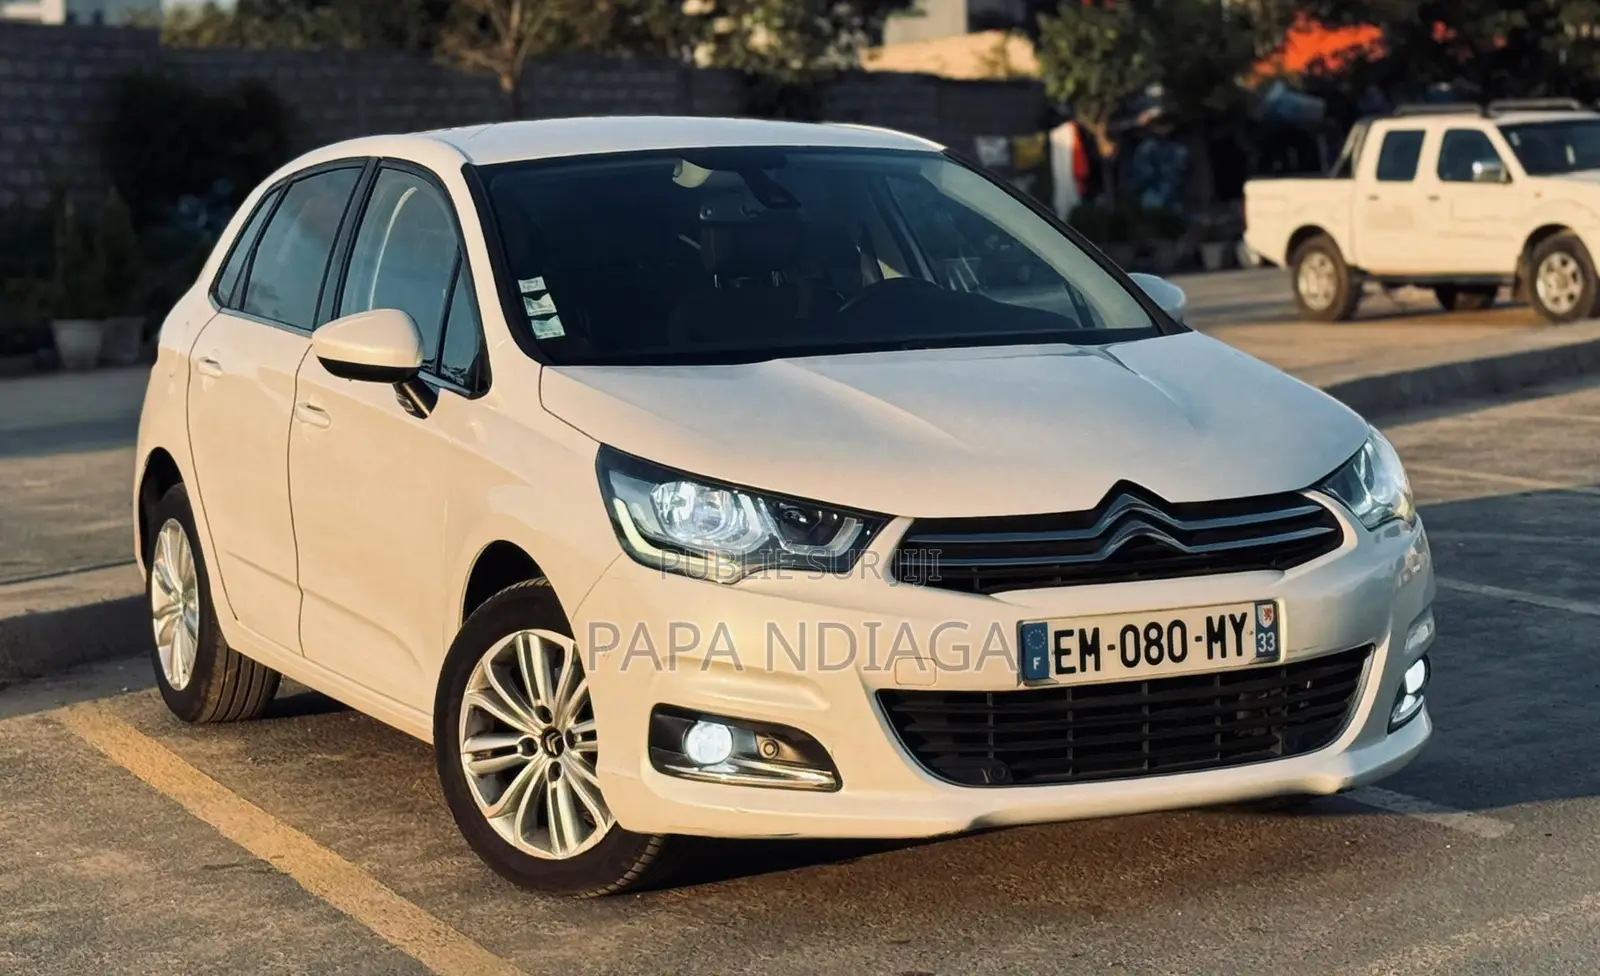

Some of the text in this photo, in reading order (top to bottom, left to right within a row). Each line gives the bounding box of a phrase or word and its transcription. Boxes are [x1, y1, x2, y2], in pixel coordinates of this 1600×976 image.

[1053, 612, 1248, 675] EM-080-MY
[1257, 631, 1276, 653] 33
[1032, 656, 1042, 671] F
